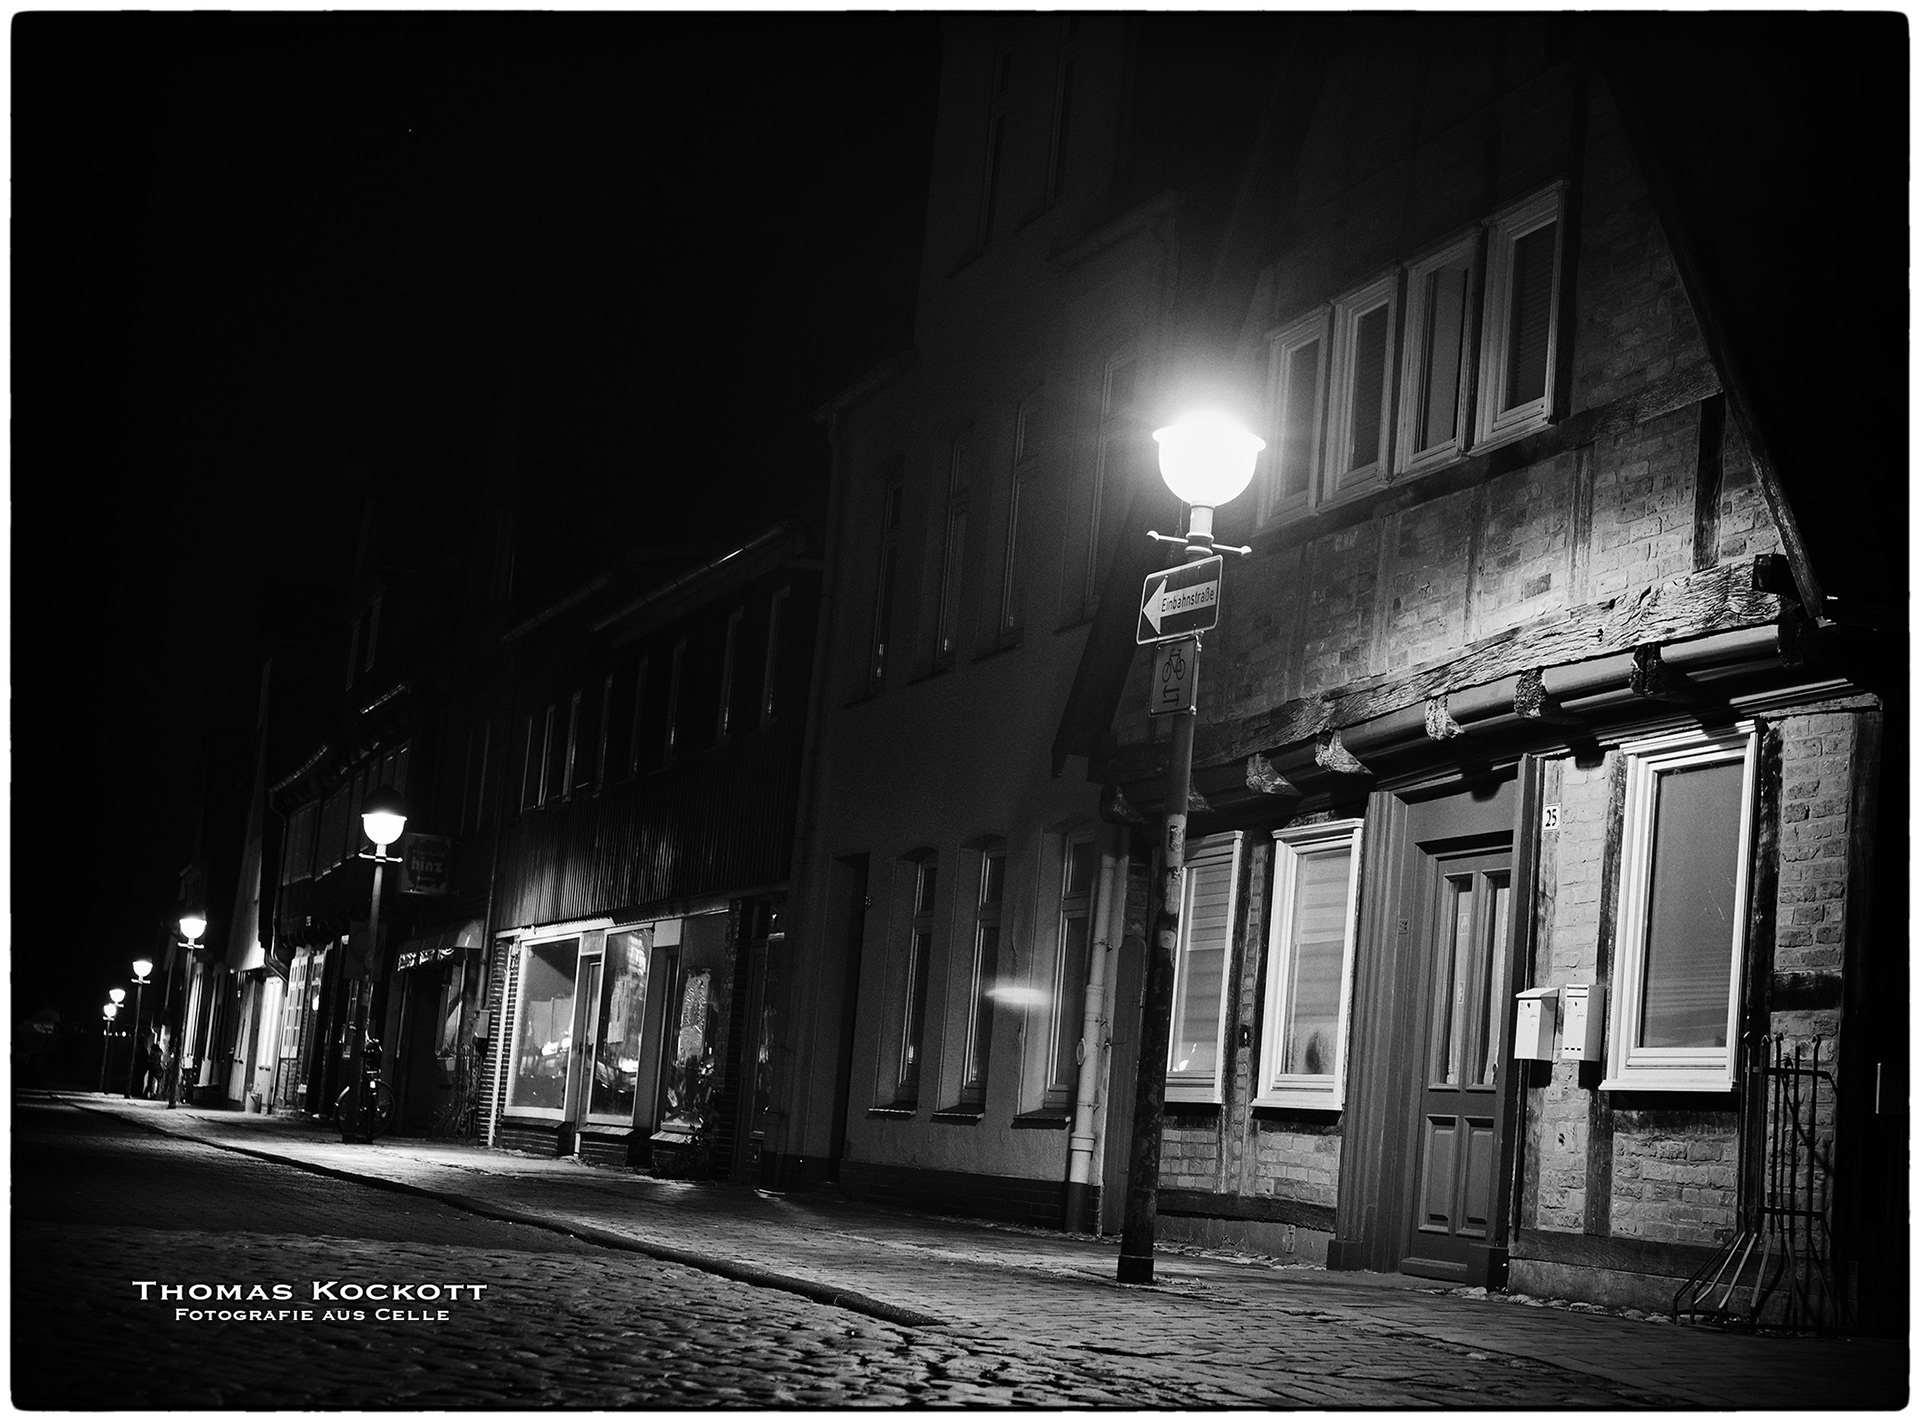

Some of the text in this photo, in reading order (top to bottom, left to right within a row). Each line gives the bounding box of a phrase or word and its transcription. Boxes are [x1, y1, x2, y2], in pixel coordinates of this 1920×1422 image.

[1161, 587, 1215, 612] Einbahnstraße
[1545, 808, 1558, 827] 25
[411, 856, 442, 873] hinz
